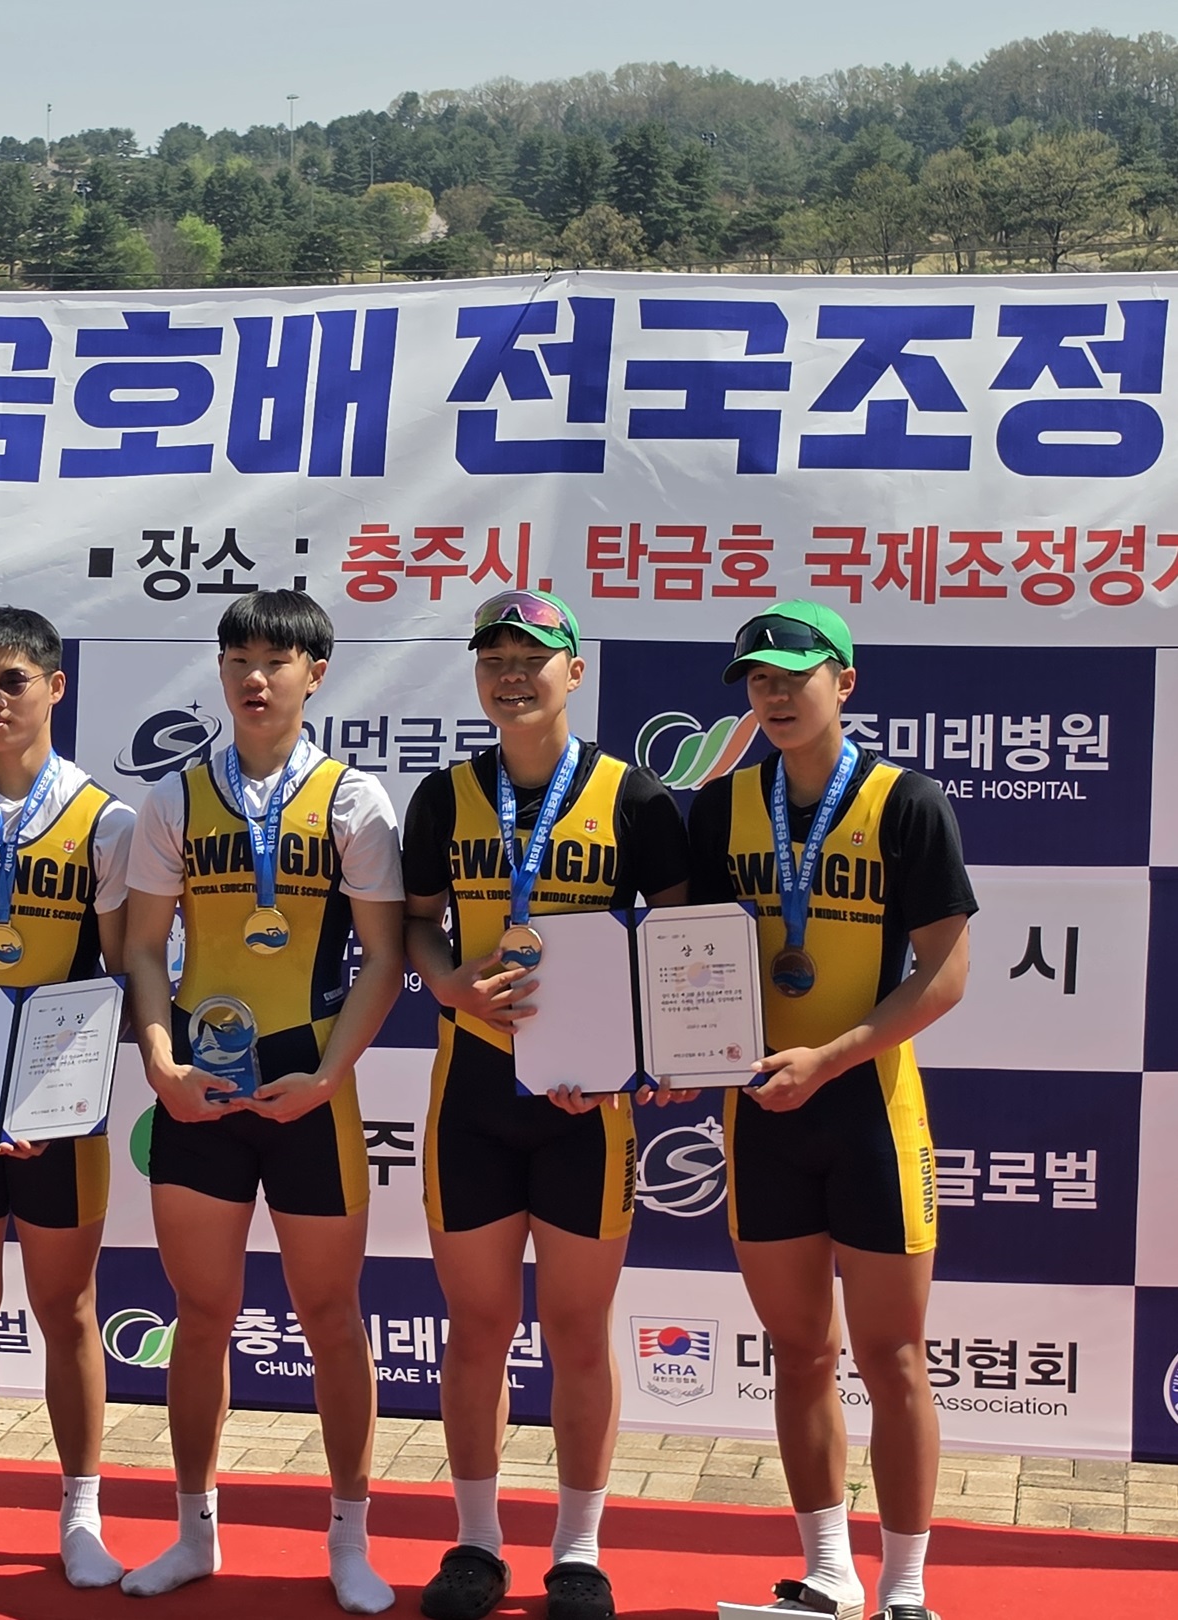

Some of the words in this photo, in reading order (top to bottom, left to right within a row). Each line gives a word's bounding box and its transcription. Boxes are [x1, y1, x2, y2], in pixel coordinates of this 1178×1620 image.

[445, 297, 1170, 478] 전국조정
[137, 526, 259, 602] 장소
[585, 522, 777, 602] 탄금호
[840, 712, 1110, 772] 주미래병원
[982, 780, 1087, 800] HOSPITAL
[301, 886, 331, 898] SCHOO
[578, 894, 613, 906] SCHOO
[52, 909, 83, 921] SCHOO
[1009, 926, 1080, 995] 시
[919, 1146, 934, 1224] GWANGJU
[653, 1363, 697, 1377] KRA
